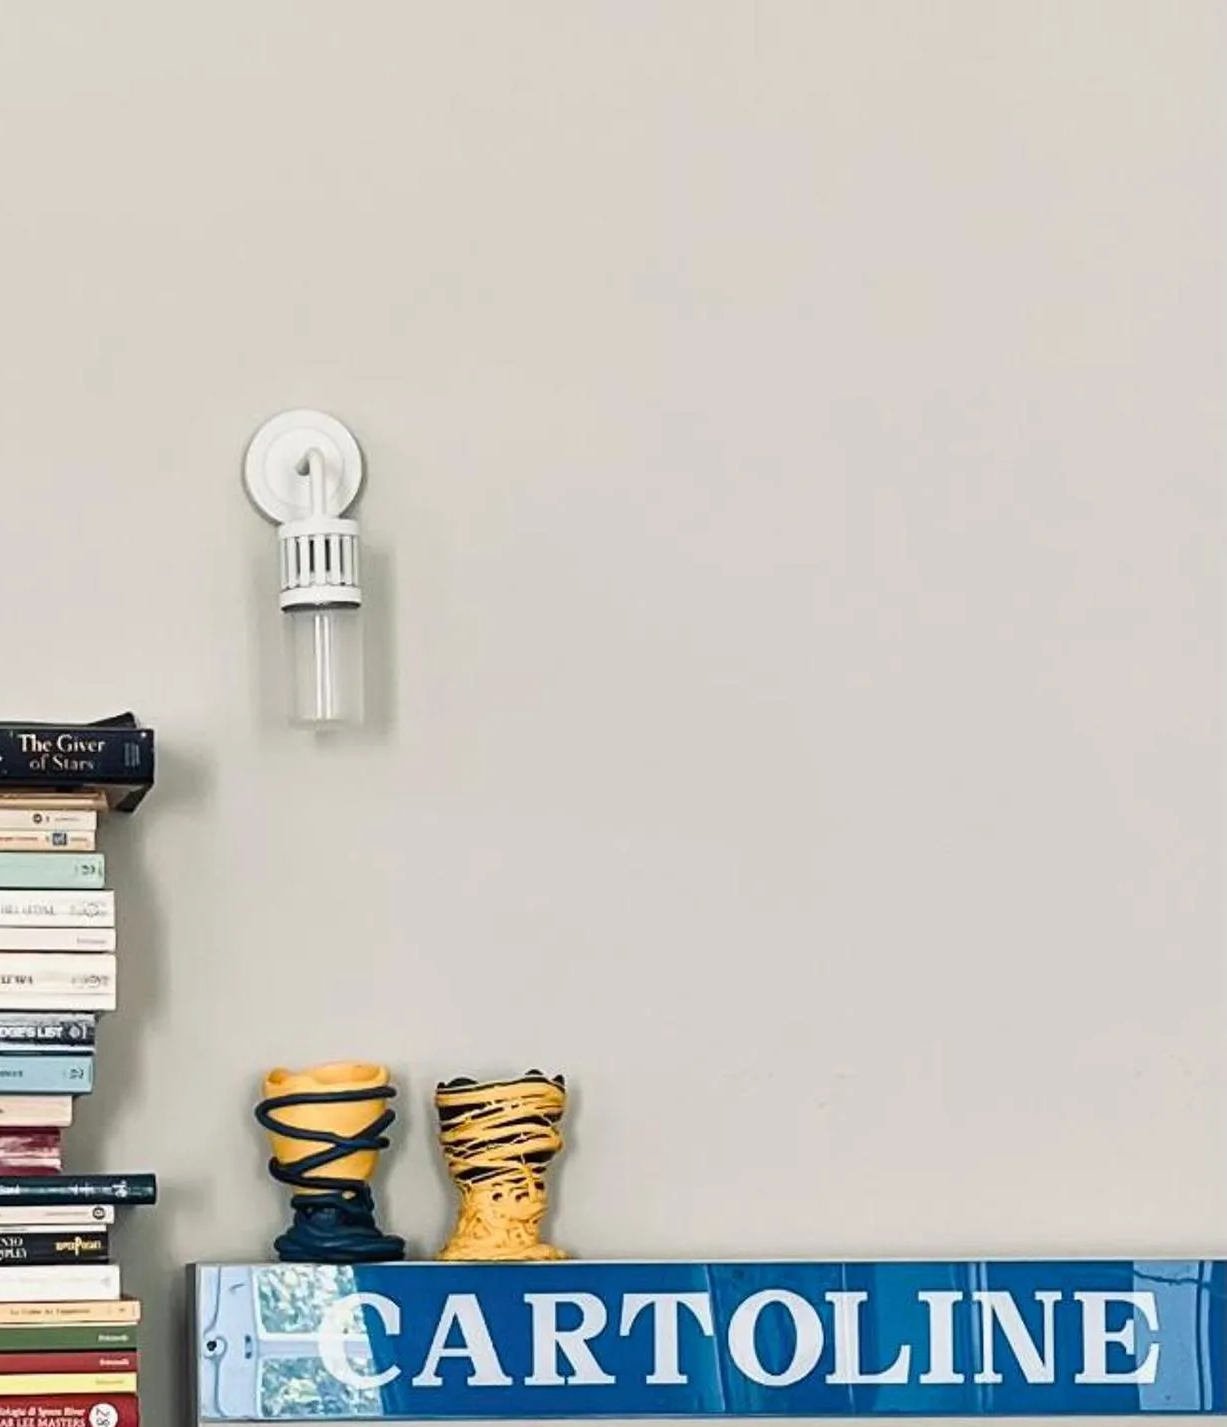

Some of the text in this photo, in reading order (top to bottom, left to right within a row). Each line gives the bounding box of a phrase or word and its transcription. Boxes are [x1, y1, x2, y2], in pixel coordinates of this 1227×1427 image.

[18, 733, 105, 753] The Giver
[29, 753, 94, 770] of Stars
[316, 1289, 1160, 1388] CARTOLINE
[16, 1417, 35, 1427] LEE
[37, 1416, 86, 1427] MASTERS
